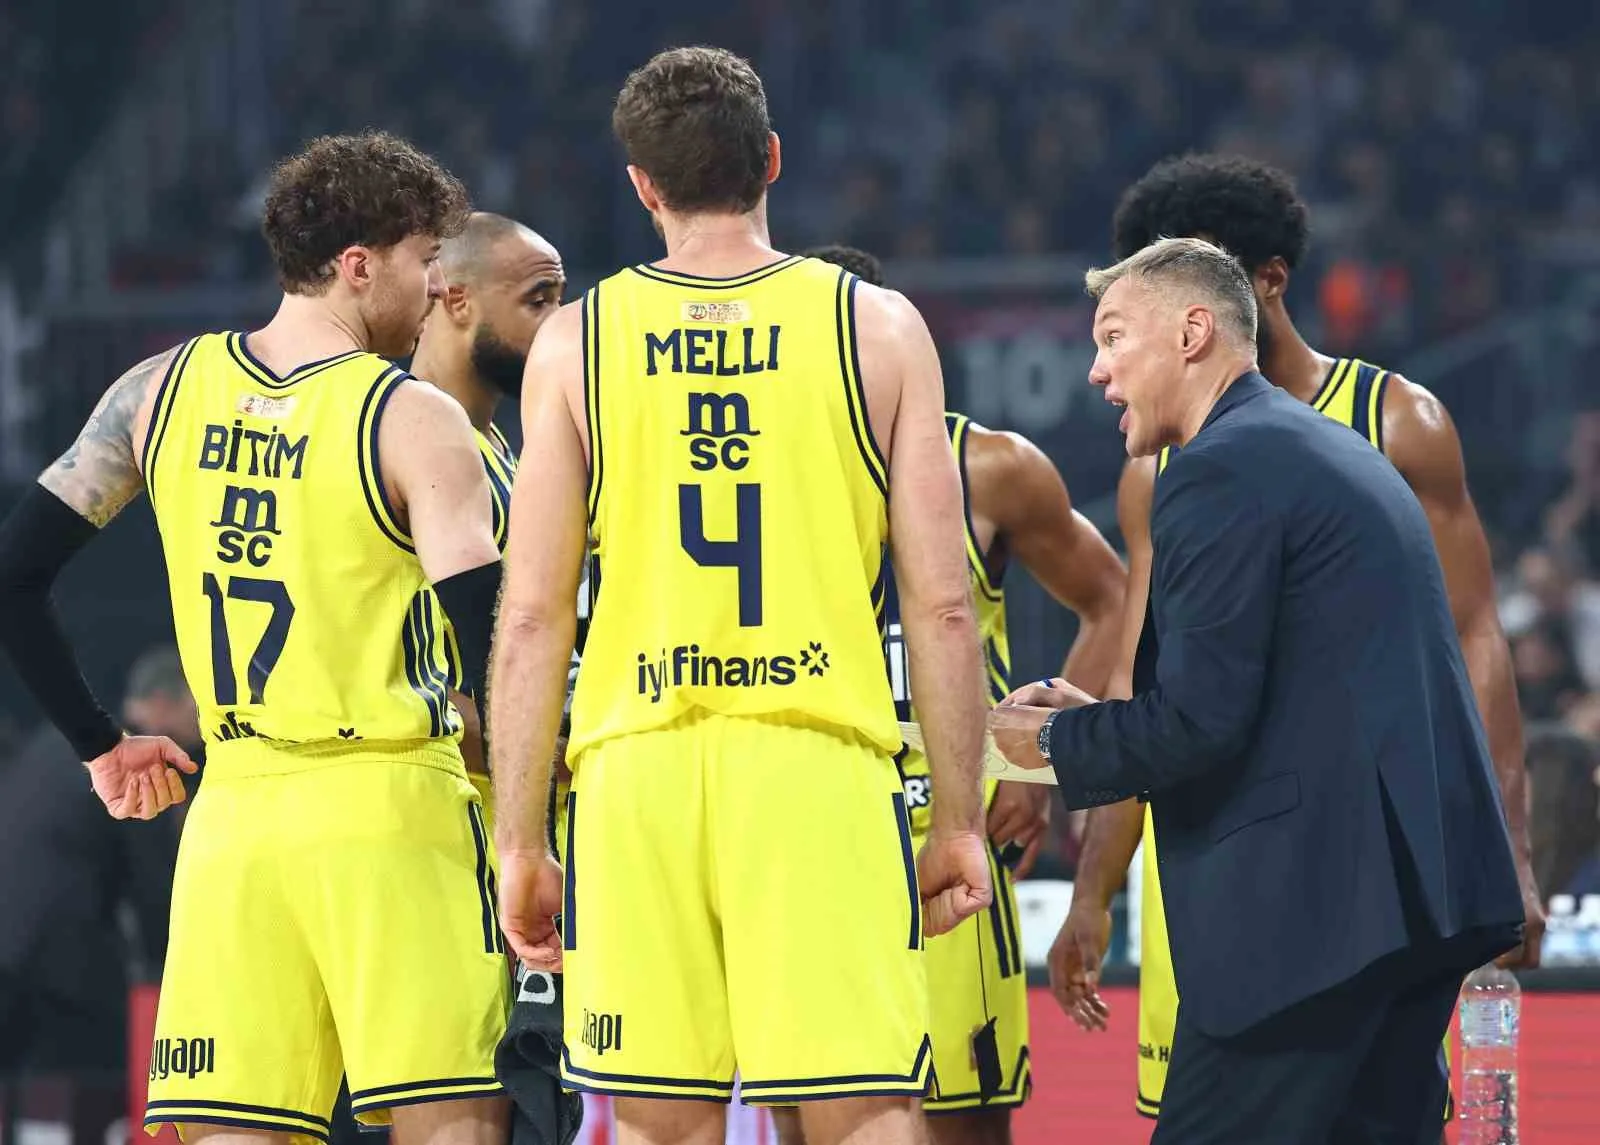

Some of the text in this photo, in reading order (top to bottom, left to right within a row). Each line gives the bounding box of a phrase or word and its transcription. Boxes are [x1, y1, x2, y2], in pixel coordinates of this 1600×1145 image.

[646, 325, 780, 376] MELLI
[679, 483, 762, 627] 4
[203, 572, 295, 705] 17
